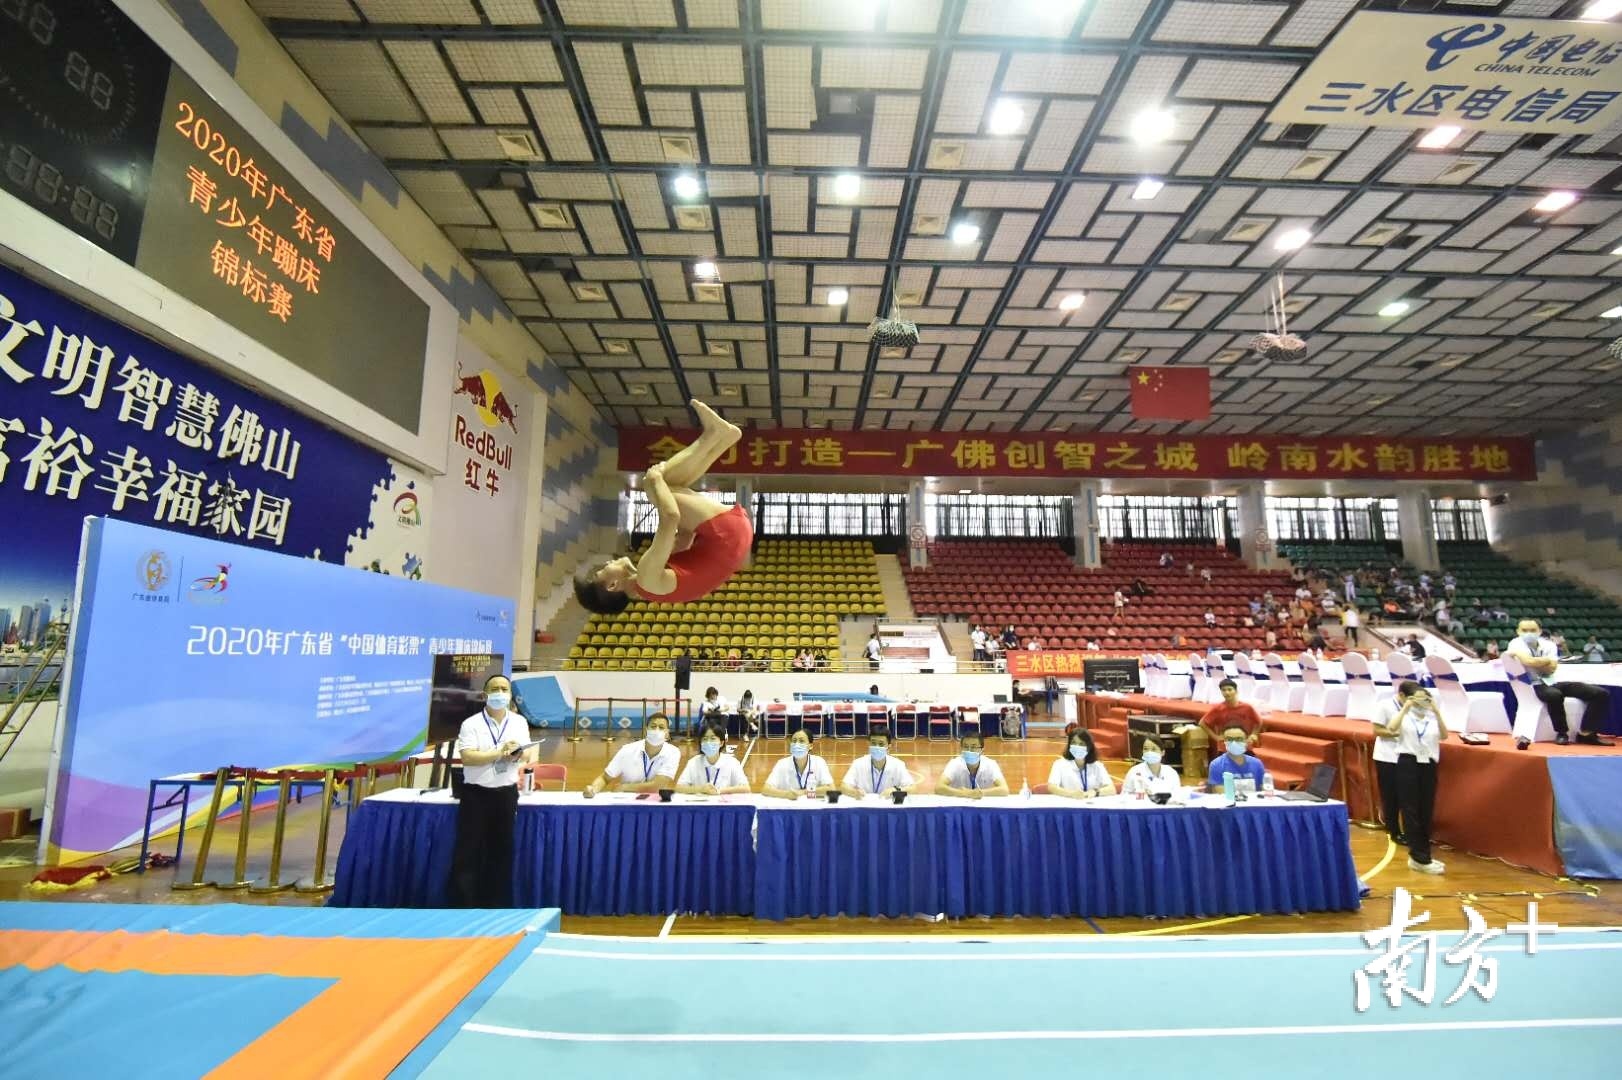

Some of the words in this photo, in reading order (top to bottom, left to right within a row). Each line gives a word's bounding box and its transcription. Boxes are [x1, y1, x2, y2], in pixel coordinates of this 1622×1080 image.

[1496, 31, 1622, 65] 中国电信
[1474, 63, 1524, 74] CHINA
[1527, 64, 1601, 77] TELECOM
[1305, 81, 1622, 124] 三水区电信局
[175, 102, 336, 262] 2020年广东省
[186, 164, 321, 294] 青少年蹦床
[211, 239, 294, 323] 锦标赛
[454, 414, 513, 470] RedBull
[1227, 442, 1512, 473] 岭南水韵胜地
[465, 457, 500, 497] 红牛
